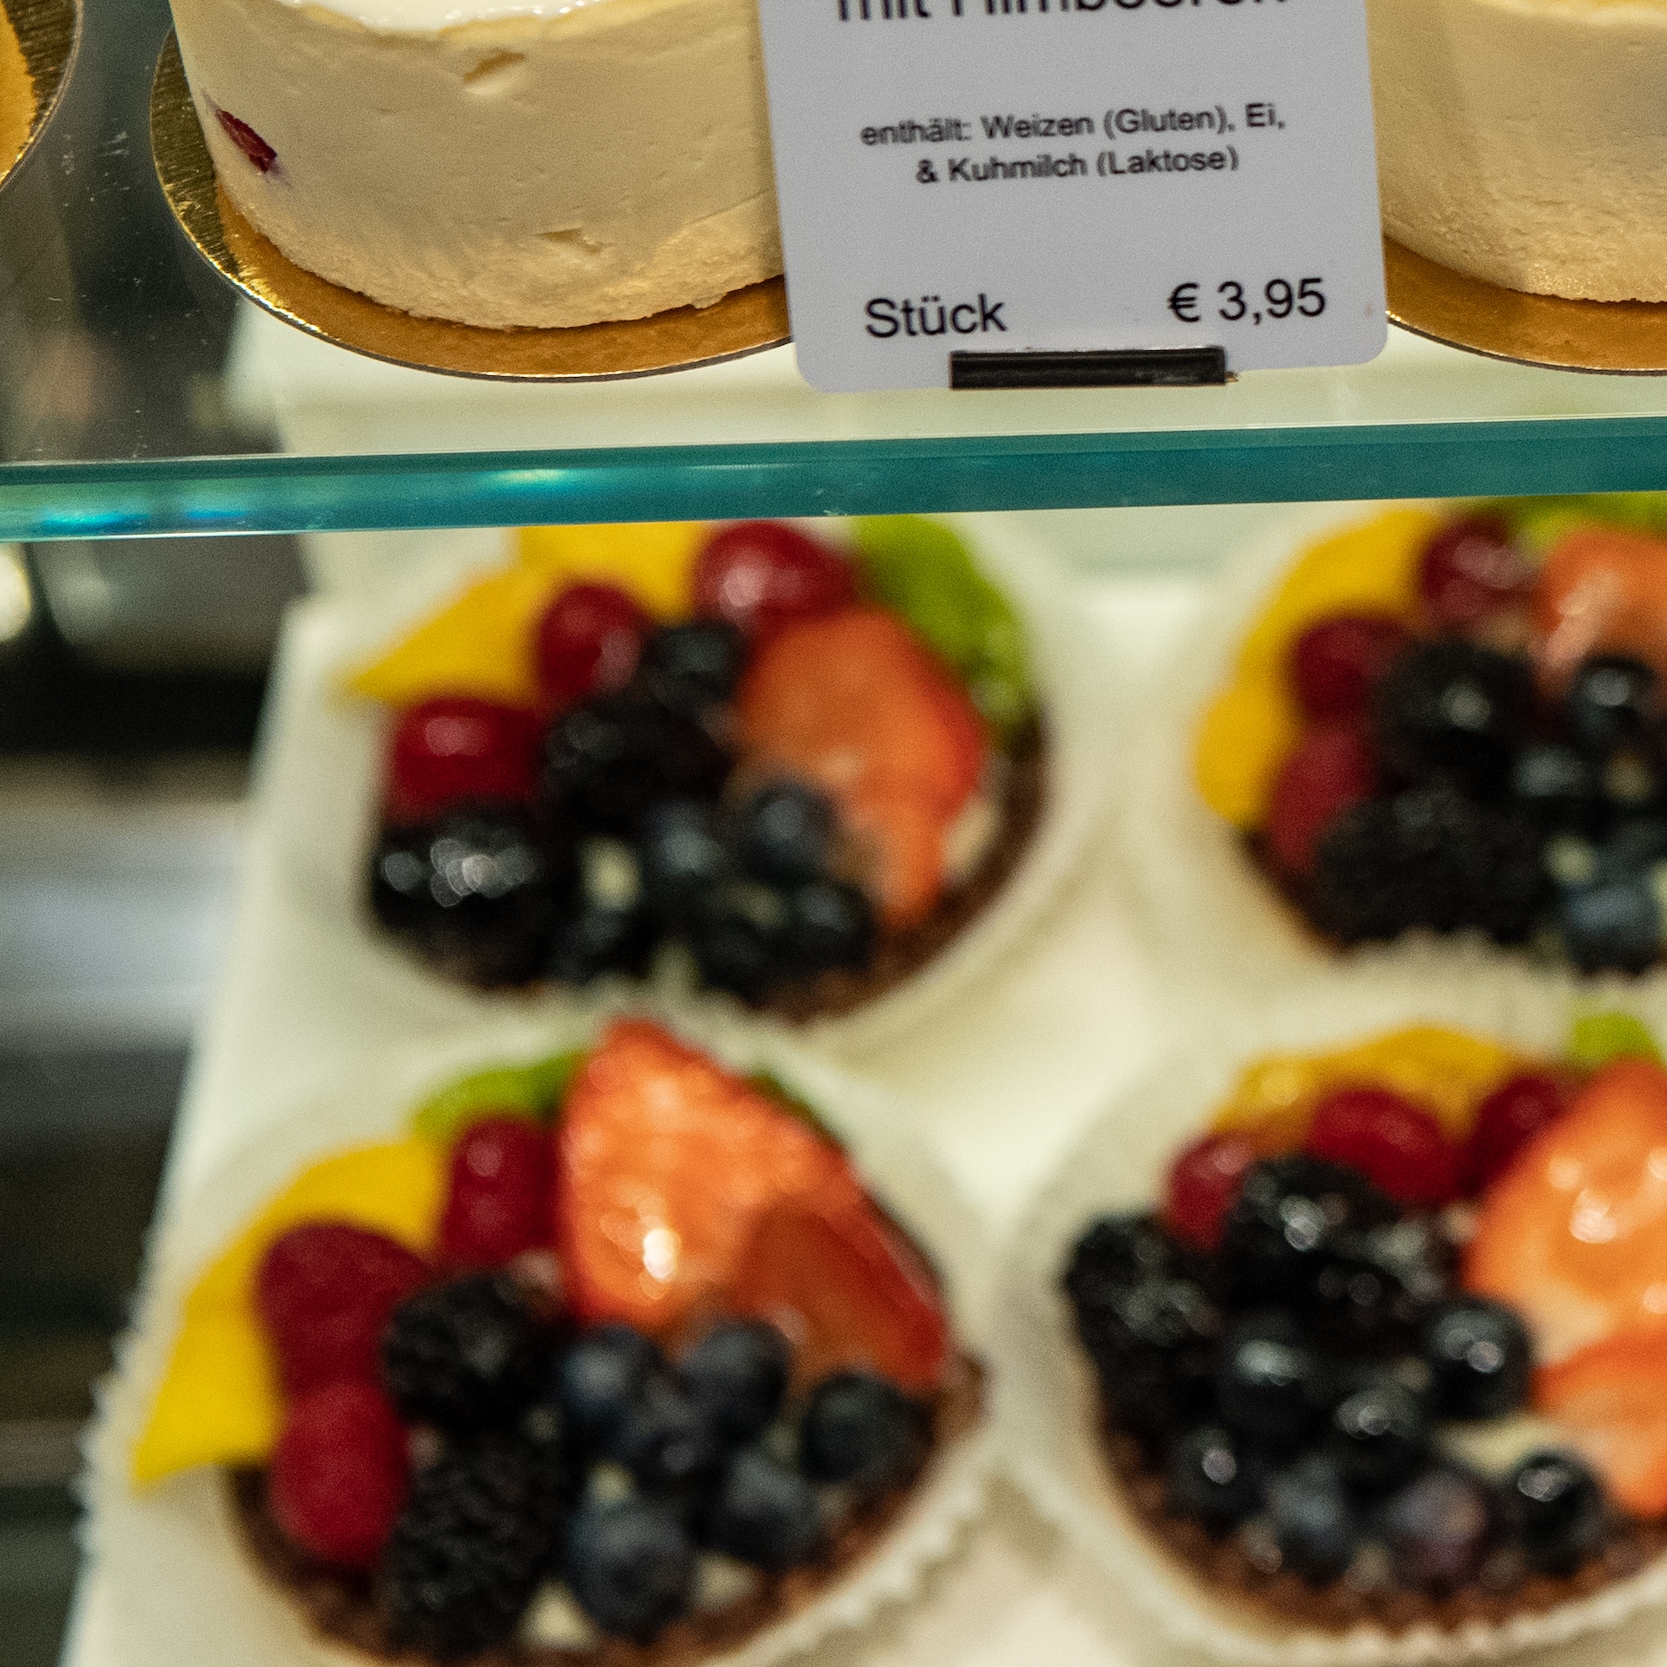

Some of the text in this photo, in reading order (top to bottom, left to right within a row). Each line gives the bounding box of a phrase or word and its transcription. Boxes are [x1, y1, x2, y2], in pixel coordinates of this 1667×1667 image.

[860, 102, 1285, 147] enthält: Weizen (Gluten), Ei,
[916, 146, 1239, 185] & Kuhmilch (Laktose)
[865, 293, 1007, 339] Stück
